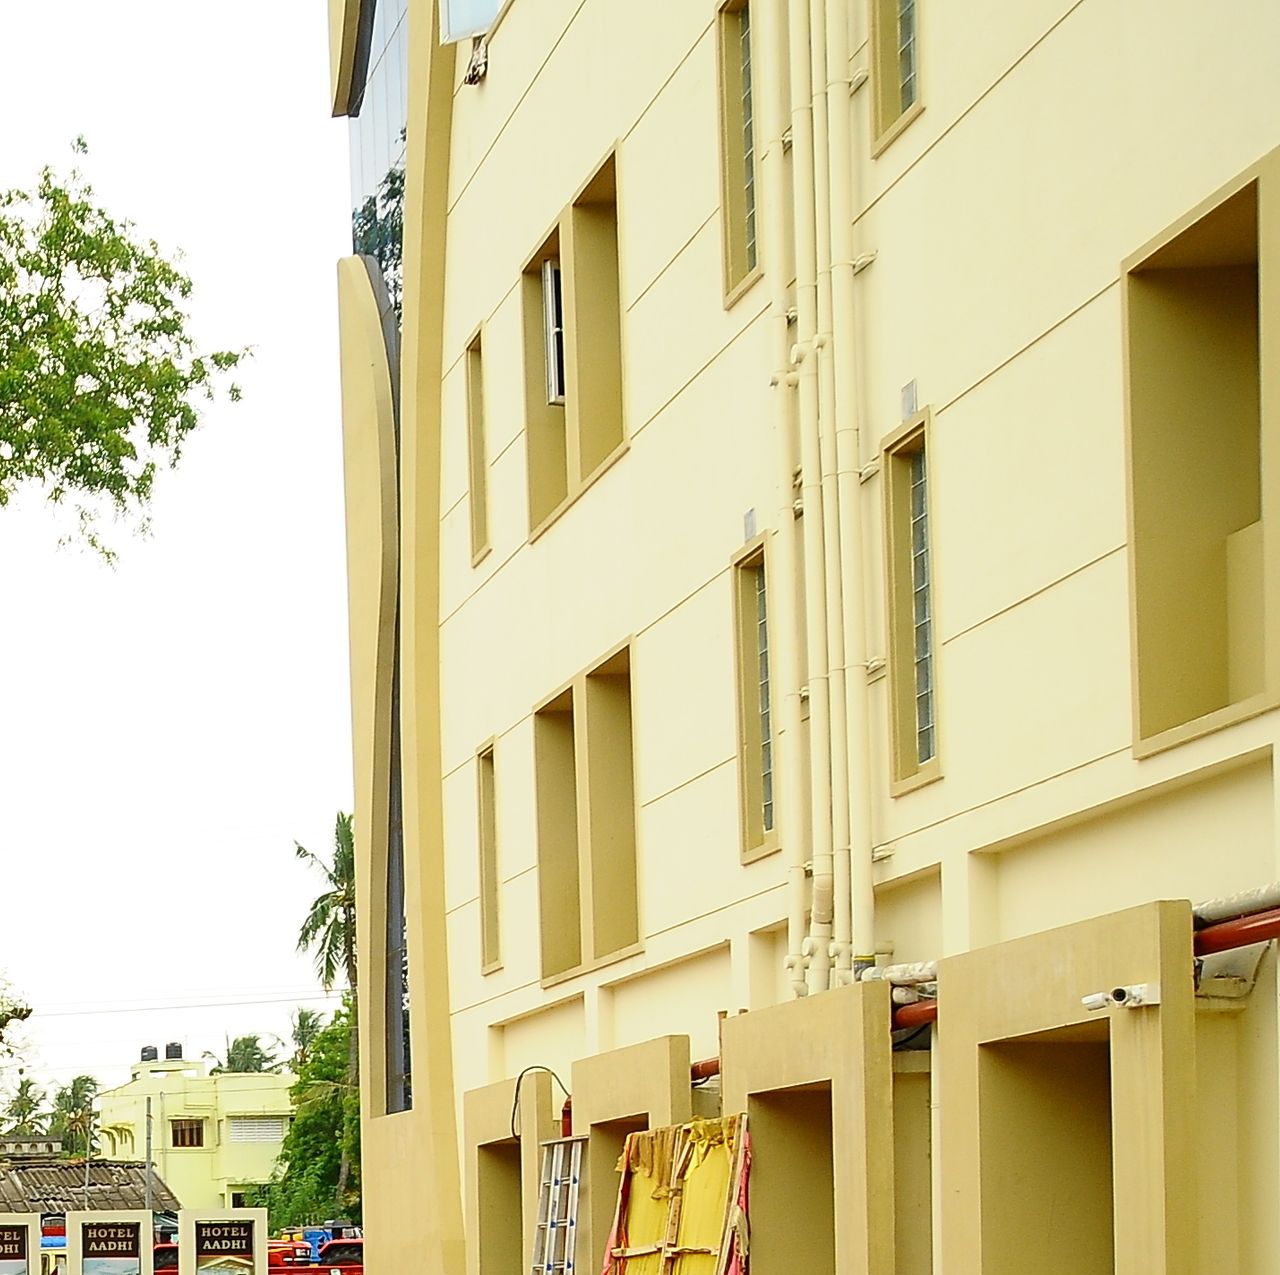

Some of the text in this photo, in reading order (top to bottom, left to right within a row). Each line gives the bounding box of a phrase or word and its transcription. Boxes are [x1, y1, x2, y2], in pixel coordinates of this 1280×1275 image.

[87, 1228, 134, 1239] HOTEL
[202, 1227, 248, 1237] HOTEL
[89, 1241, 133, 1251] AADHI
[203, 1239, 247, 1250] AADHI
